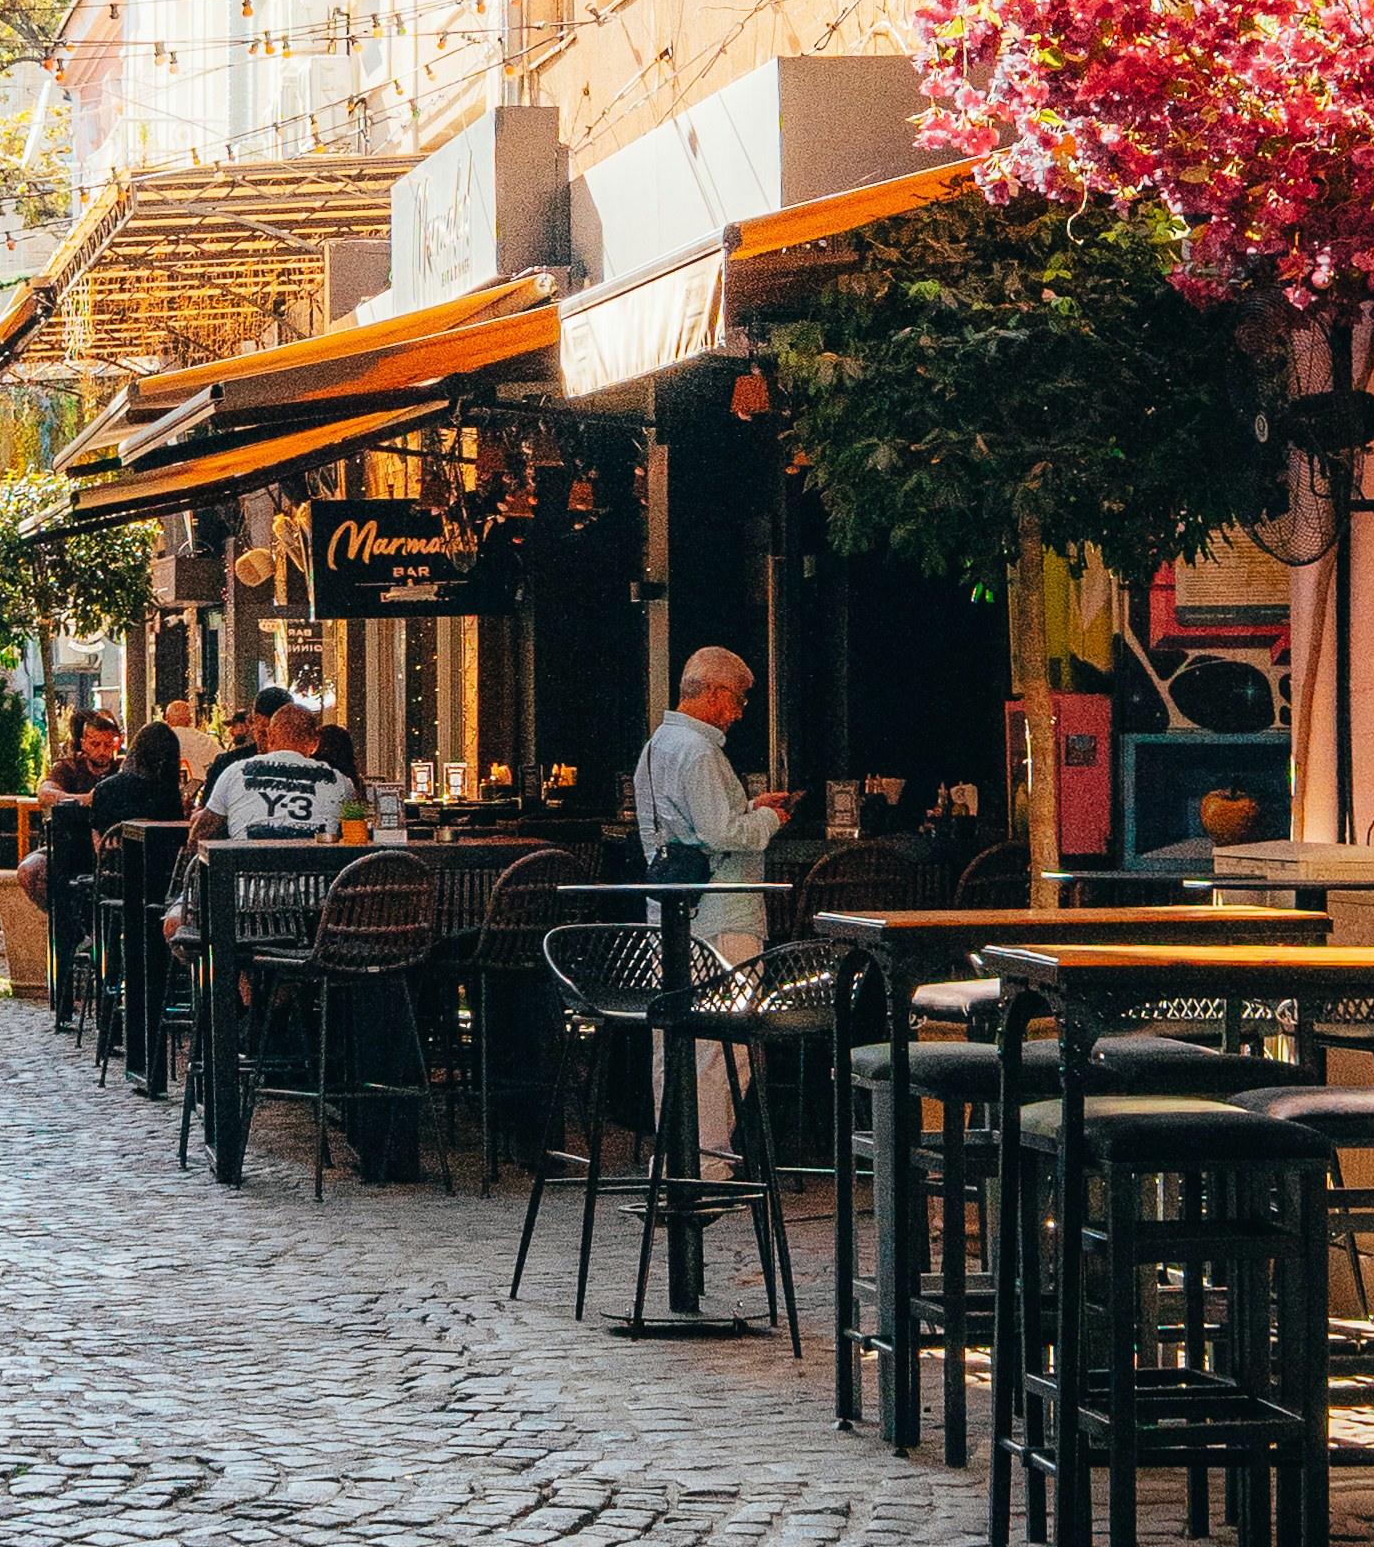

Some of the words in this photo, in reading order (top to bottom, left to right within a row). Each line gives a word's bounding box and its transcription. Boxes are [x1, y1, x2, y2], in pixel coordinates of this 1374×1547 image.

[328, 520, 471, 571] Marma
[392, 566, 430, 578] BAR
[258, 791, 313, 822] Y-3
